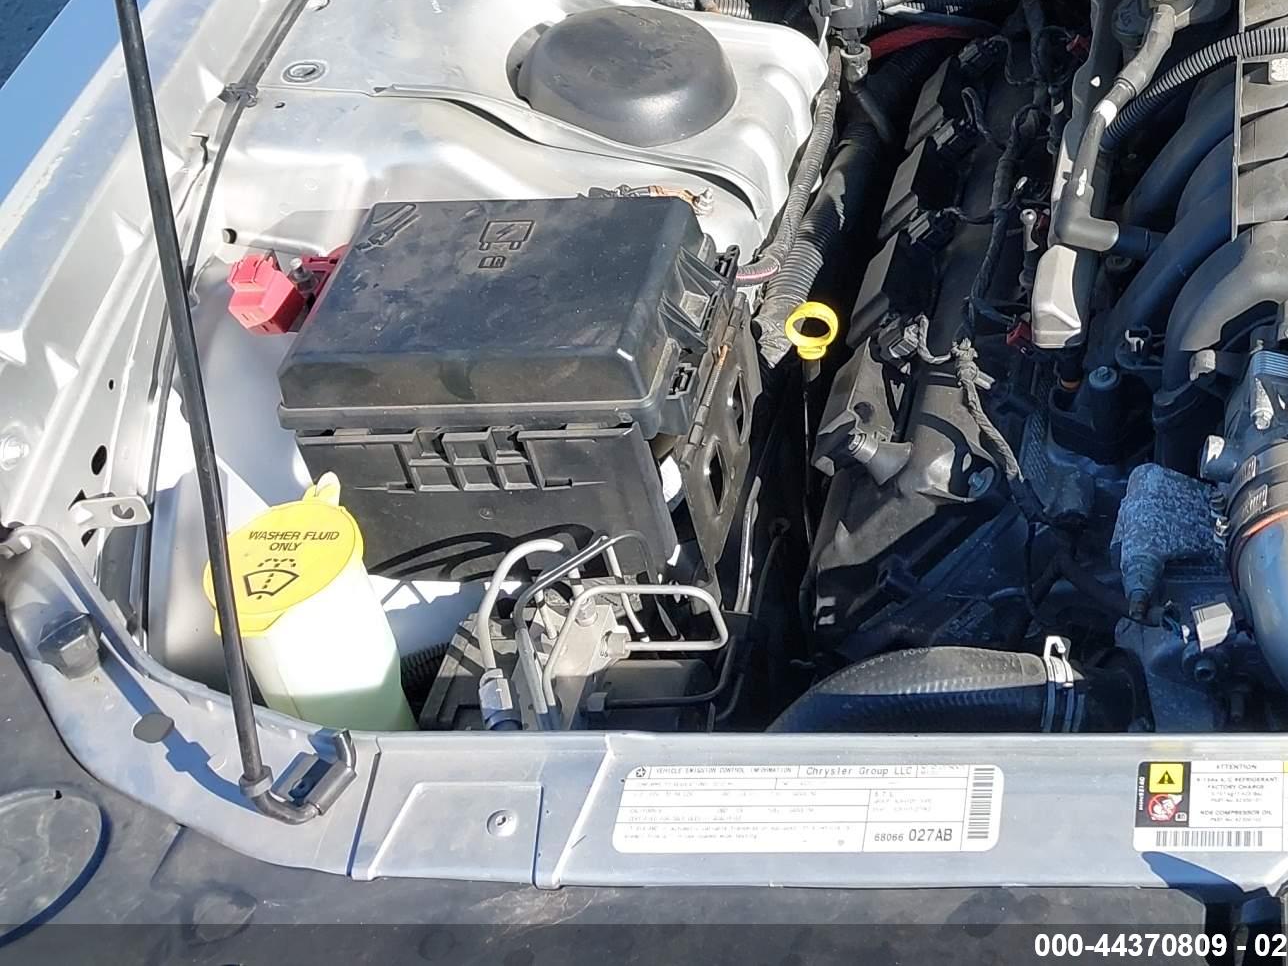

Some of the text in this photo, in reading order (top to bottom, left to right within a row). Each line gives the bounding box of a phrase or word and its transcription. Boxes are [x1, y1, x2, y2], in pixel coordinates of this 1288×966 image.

[249, 531, 340, 540] WASHER FLUID
[269, 542, 302, 551] ONLY
[806, 766, 852, 778] Chrysler
[859, 766, 889, 778] Group
[894, 766, 913, 775] LLC
[908, 829, 953, 842] 027AB
